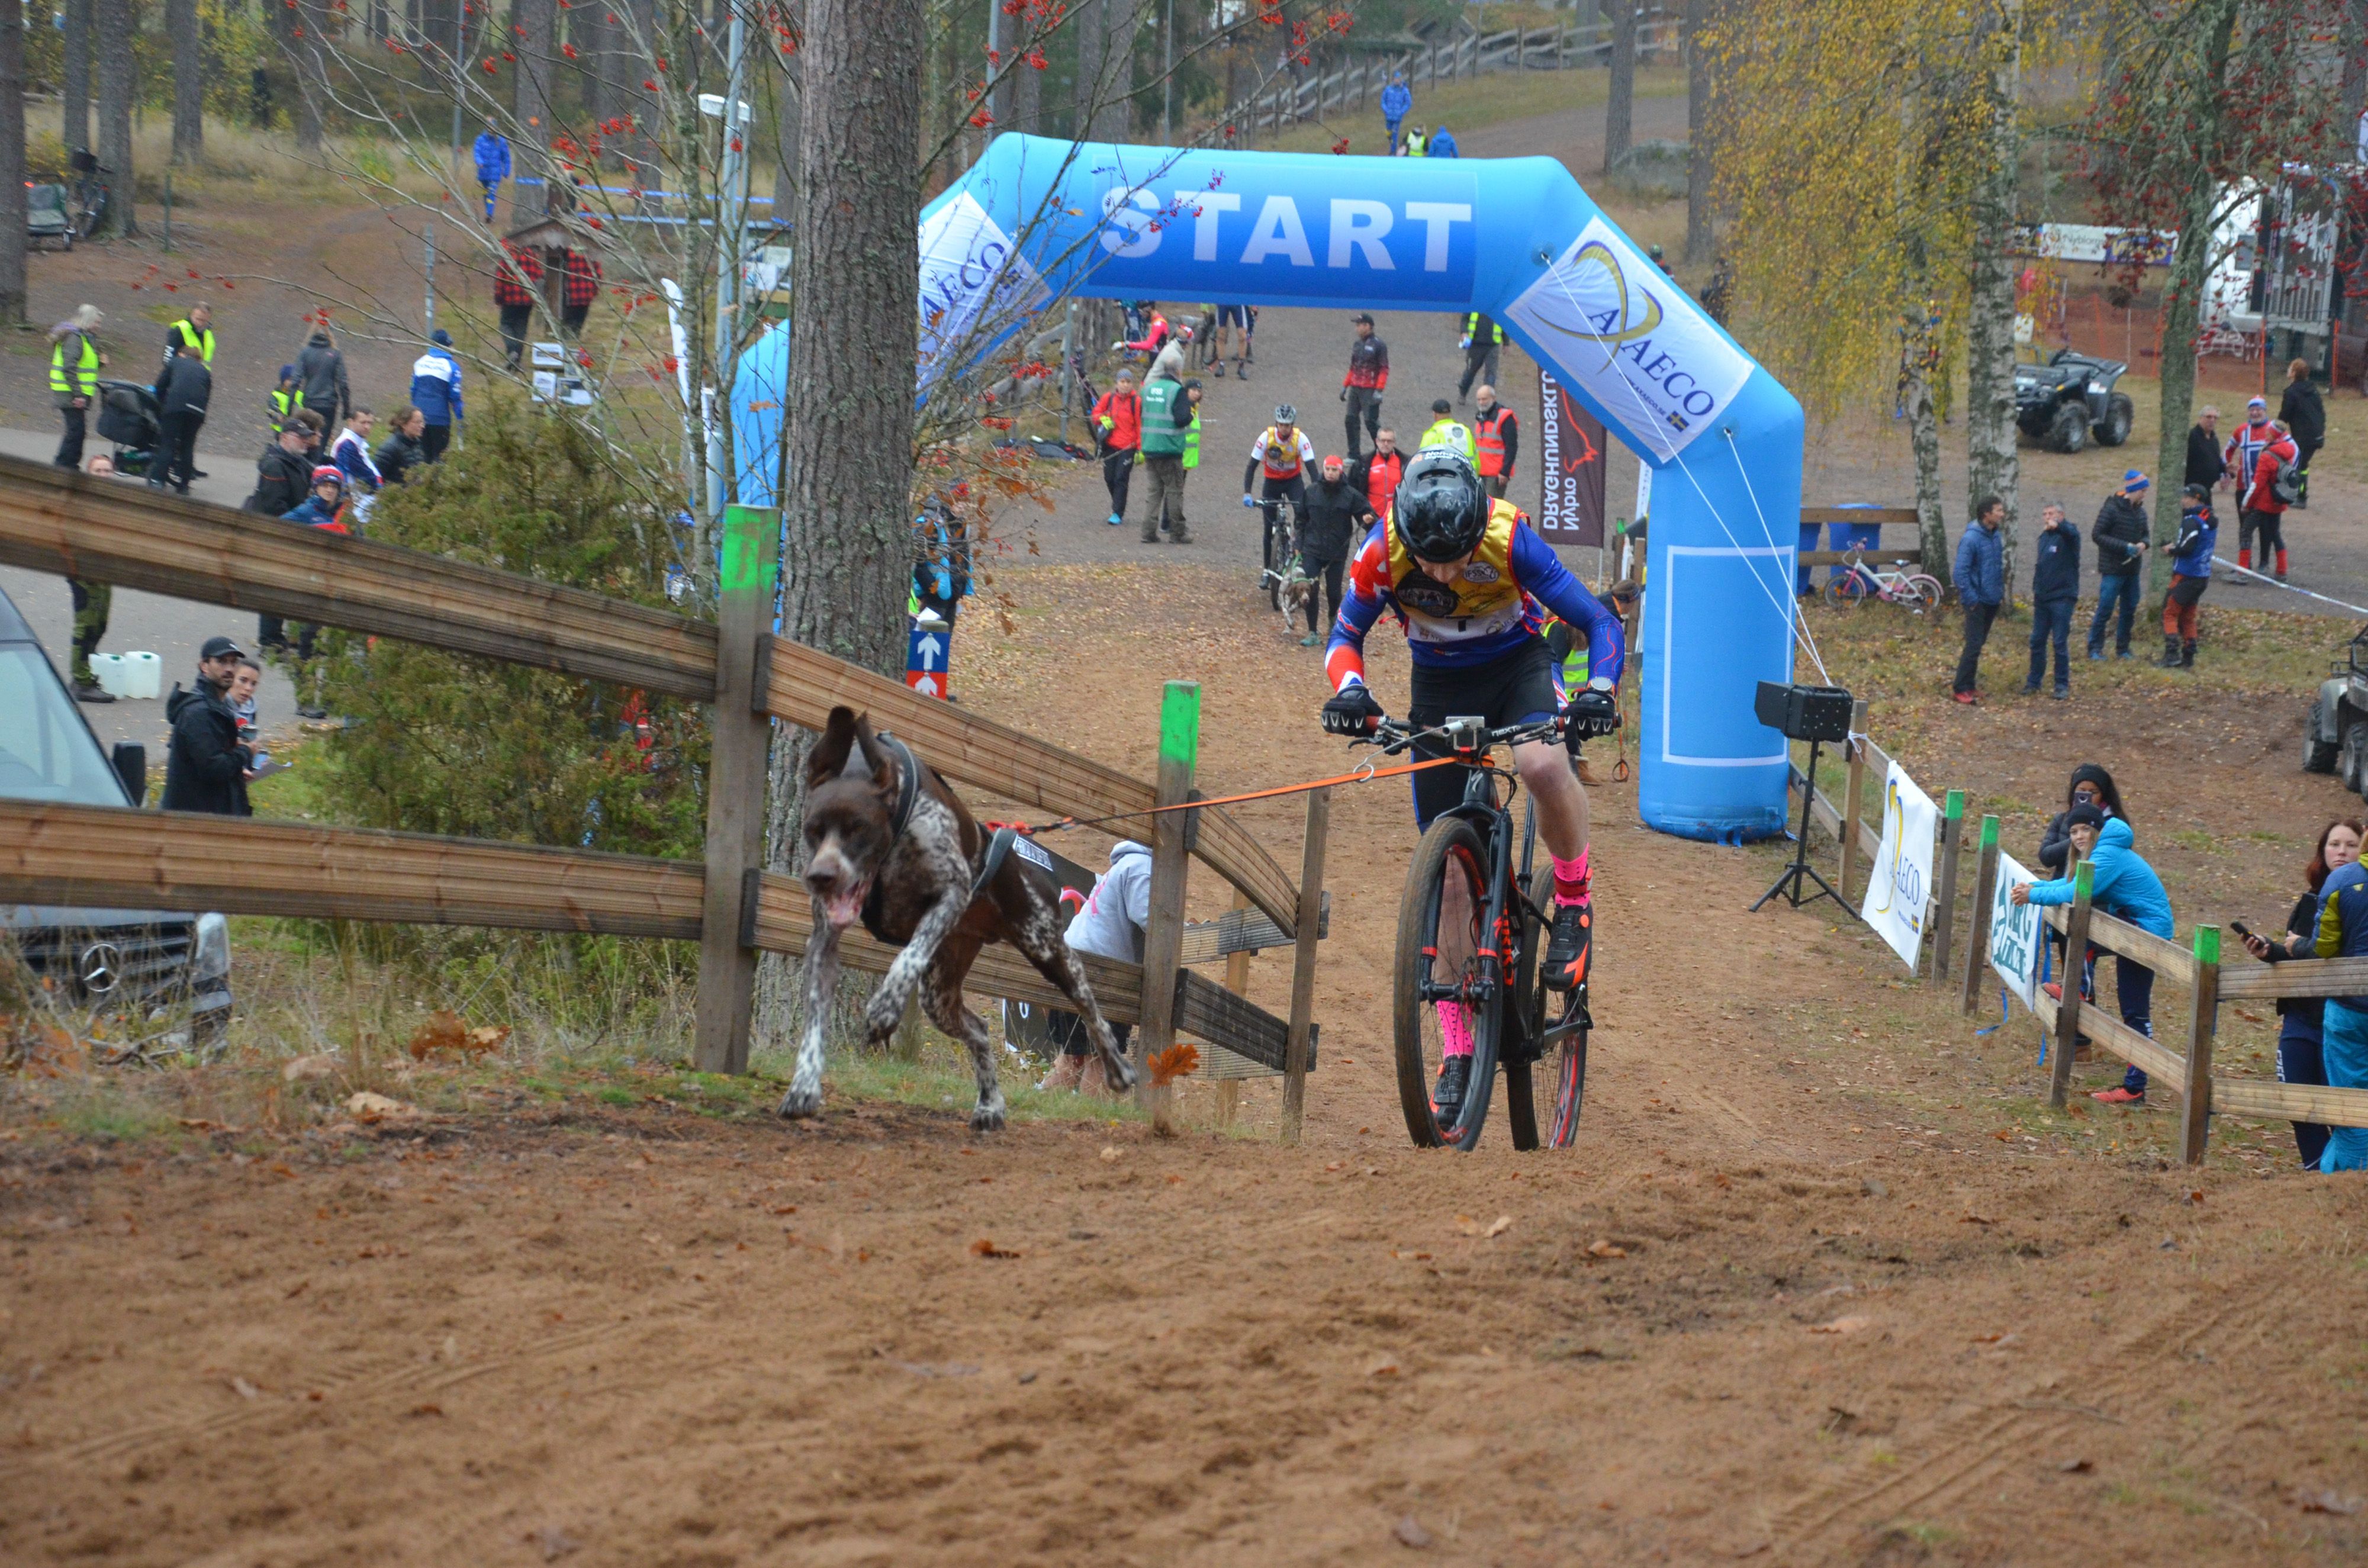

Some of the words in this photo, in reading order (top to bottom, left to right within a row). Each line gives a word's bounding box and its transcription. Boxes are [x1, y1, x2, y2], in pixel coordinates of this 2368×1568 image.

[1099, 185, 1472, 272] START
[1620, 339, 1714, 417] AECO
[2277, 1049, 2286, 1083] CZEC
